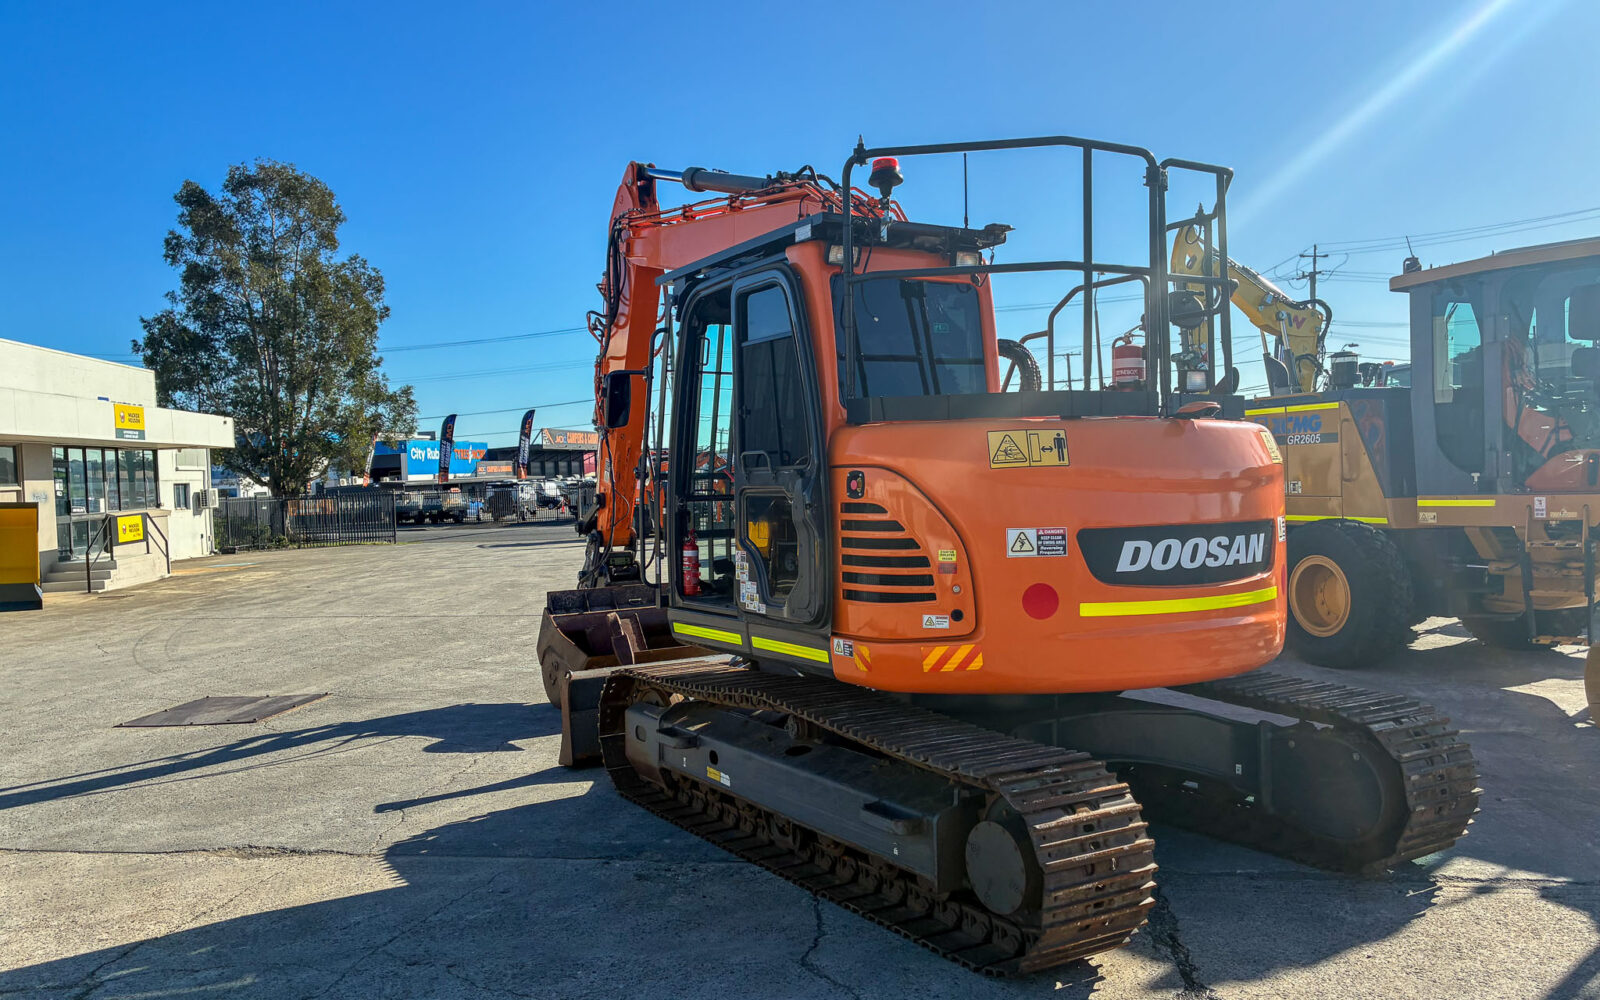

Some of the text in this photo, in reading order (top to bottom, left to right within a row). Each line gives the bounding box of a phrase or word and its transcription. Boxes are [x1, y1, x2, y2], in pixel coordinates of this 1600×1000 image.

[1287, 434, 1321, 445] GR2605
[410, 447, 440, 462] City Rub
[1116, 533, 1265, 572] DOOSAN
